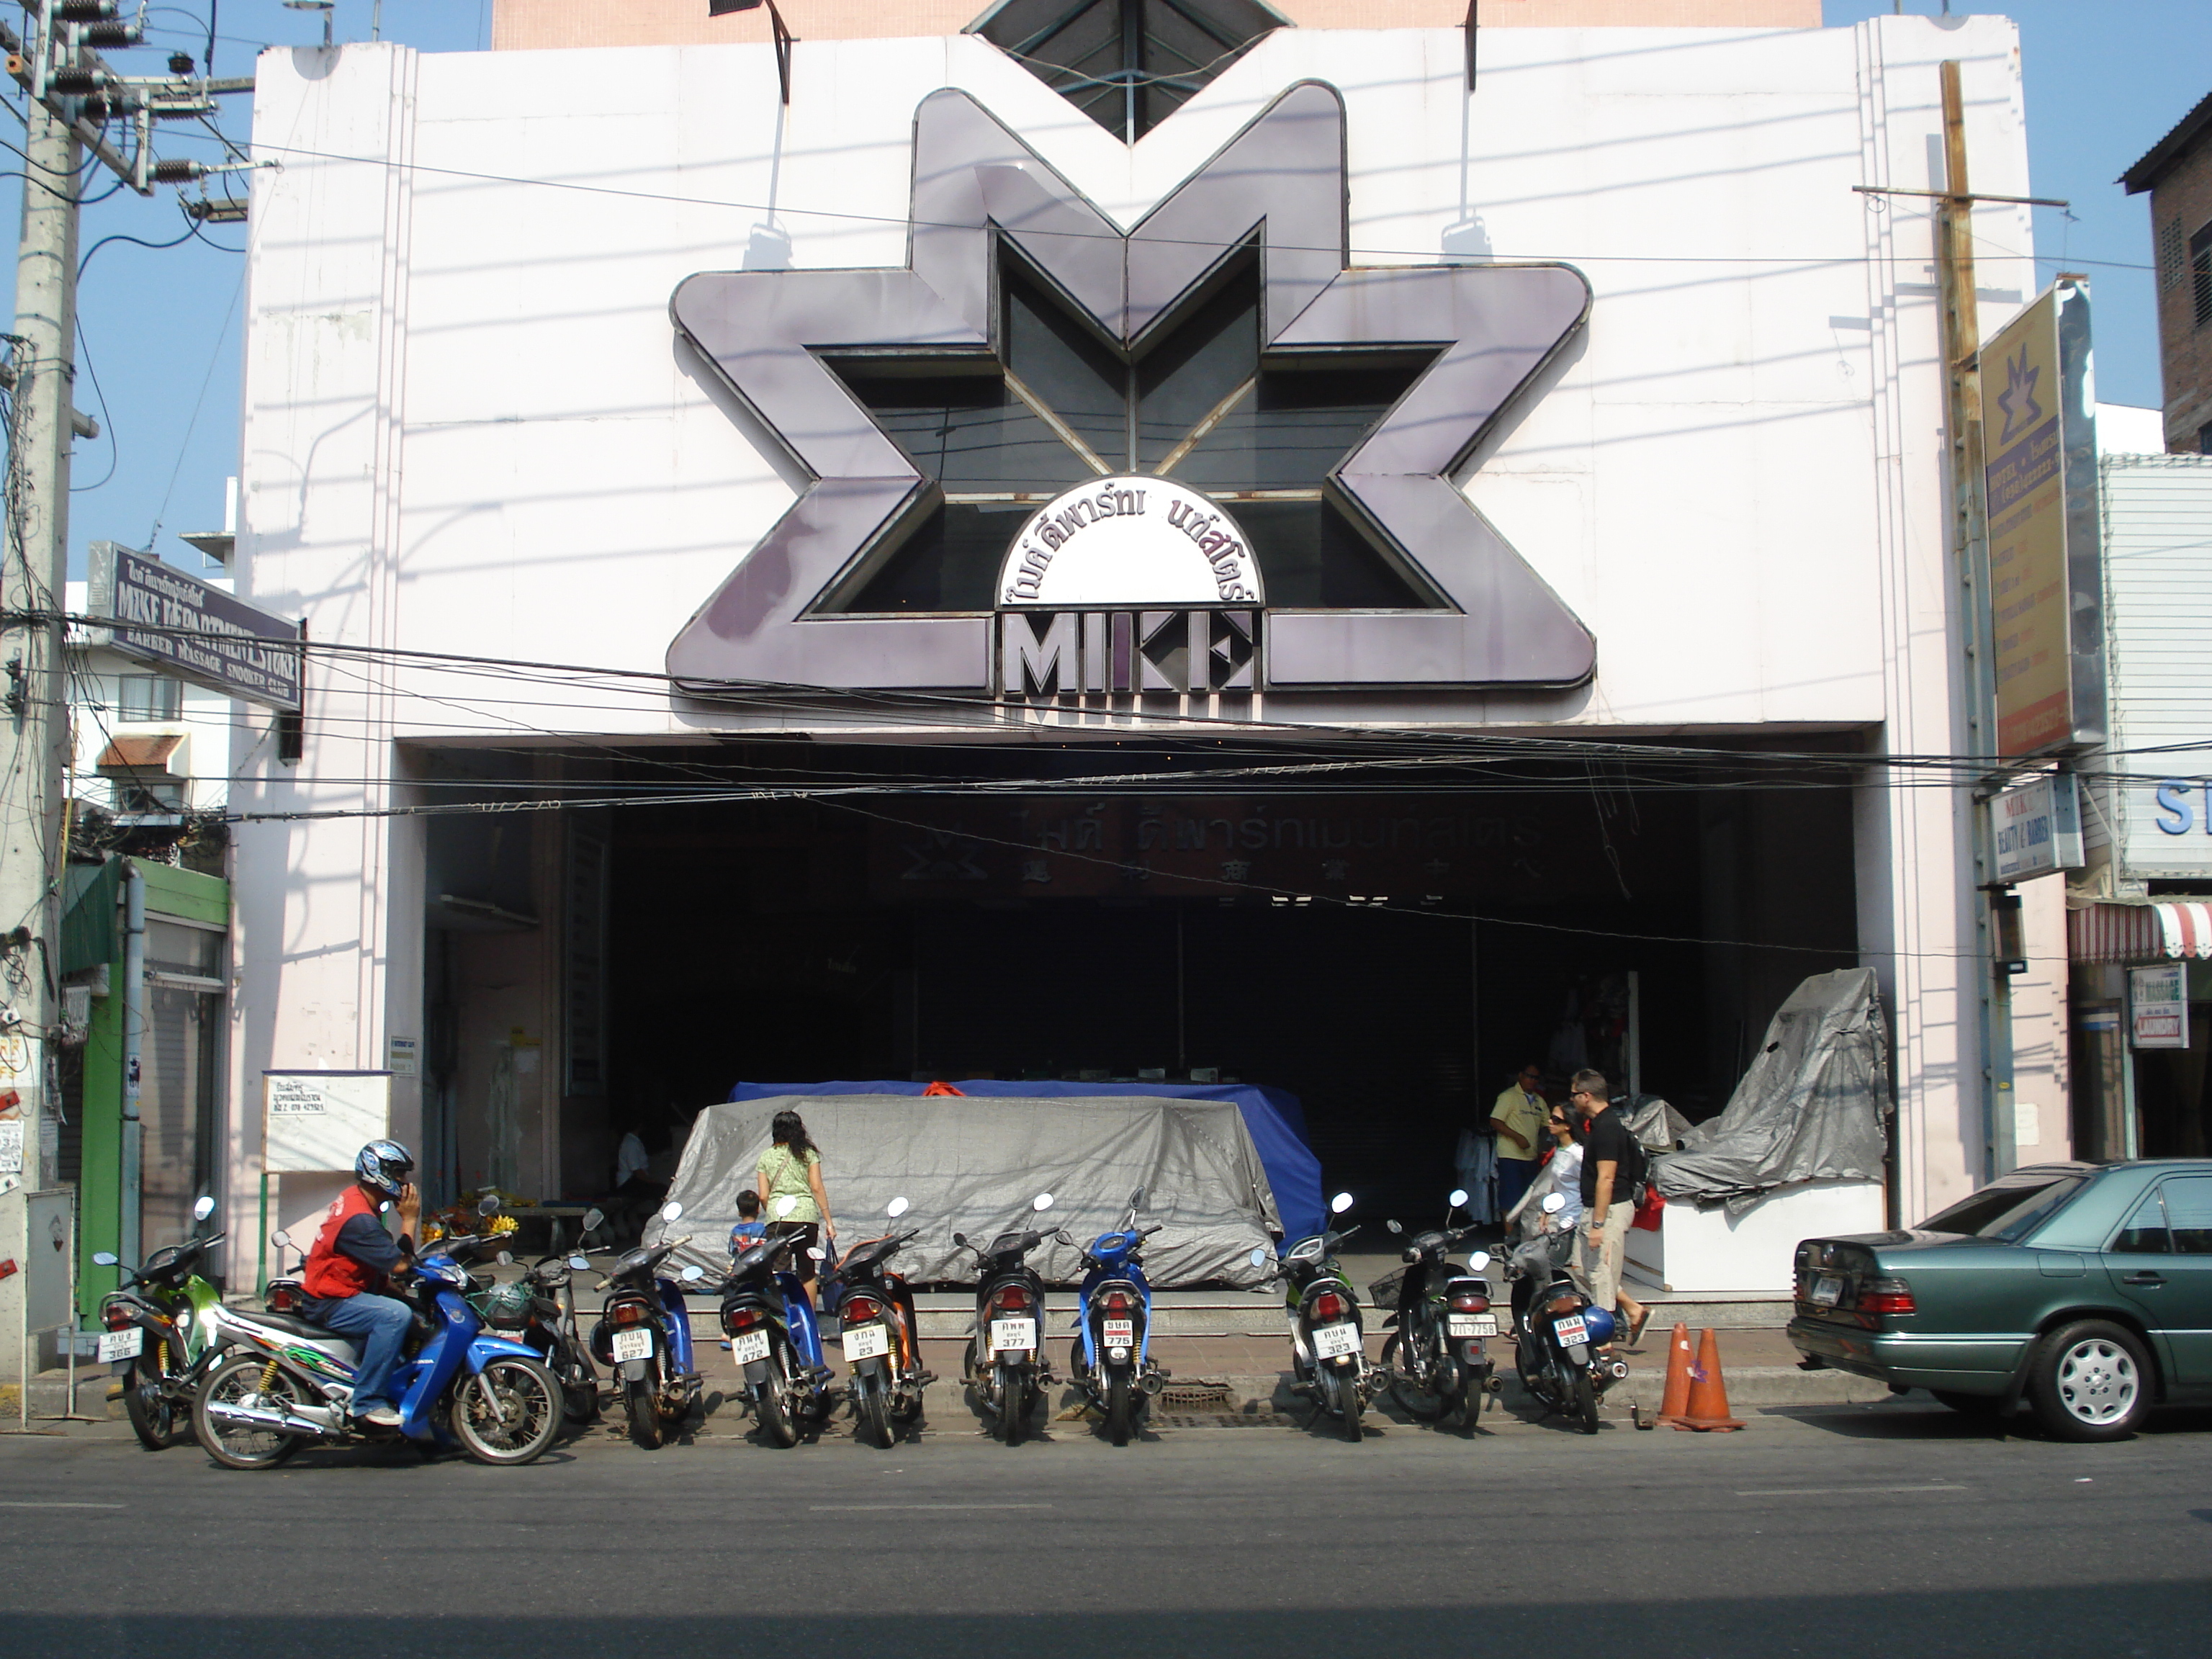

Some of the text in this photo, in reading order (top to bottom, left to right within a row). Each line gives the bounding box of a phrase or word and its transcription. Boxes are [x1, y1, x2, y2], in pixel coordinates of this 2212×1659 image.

[1003, 611, 1254, 693] MIKE
[127, 628, 289, 698] BARBER MASSAGE SNOOKER CLUB
[2156, 779, 2212, 835] S
[1002, 1338, 1025, 1347] 377
[1563, 1334, 1586, 1345] 323
[109, 1348, 130, 1359] 366
[622, 1349, 644, 1359] 627
[859, 1346, 873, 1356] 23
[1328, 1343, 1350, 1354] 323
[742, 1349, 763, 1362] 472
